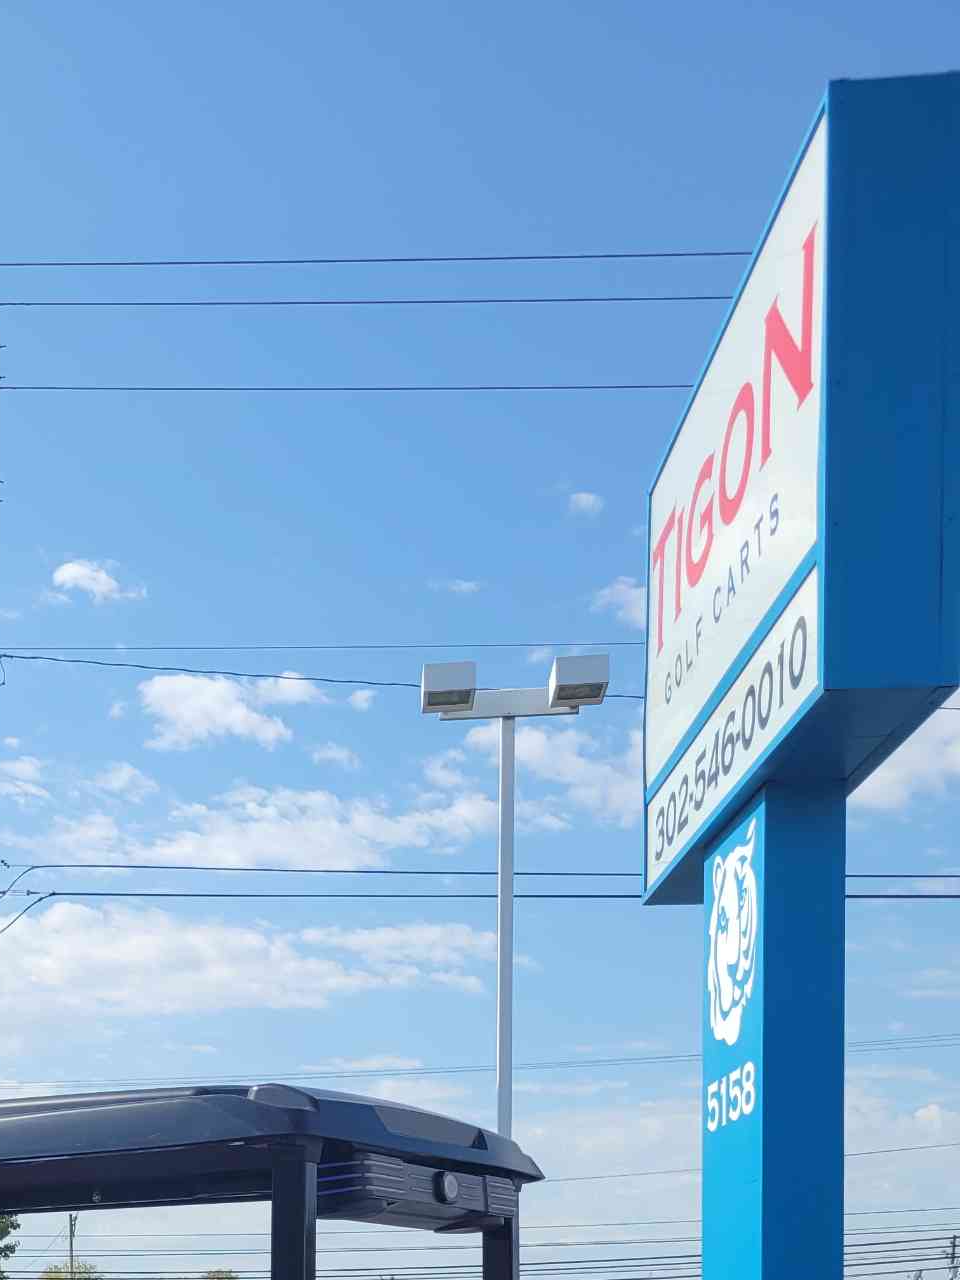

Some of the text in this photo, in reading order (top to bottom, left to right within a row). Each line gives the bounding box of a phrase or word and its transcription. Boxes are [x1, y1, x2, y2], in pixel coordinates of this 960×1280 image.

[652, 221, 817, 657] TIGON
[664, 493, 780, 705] GOLF CARTS
[654, 615, 808, 862] 302-546-0010
[707, 1060, 755, 1132] 5158
